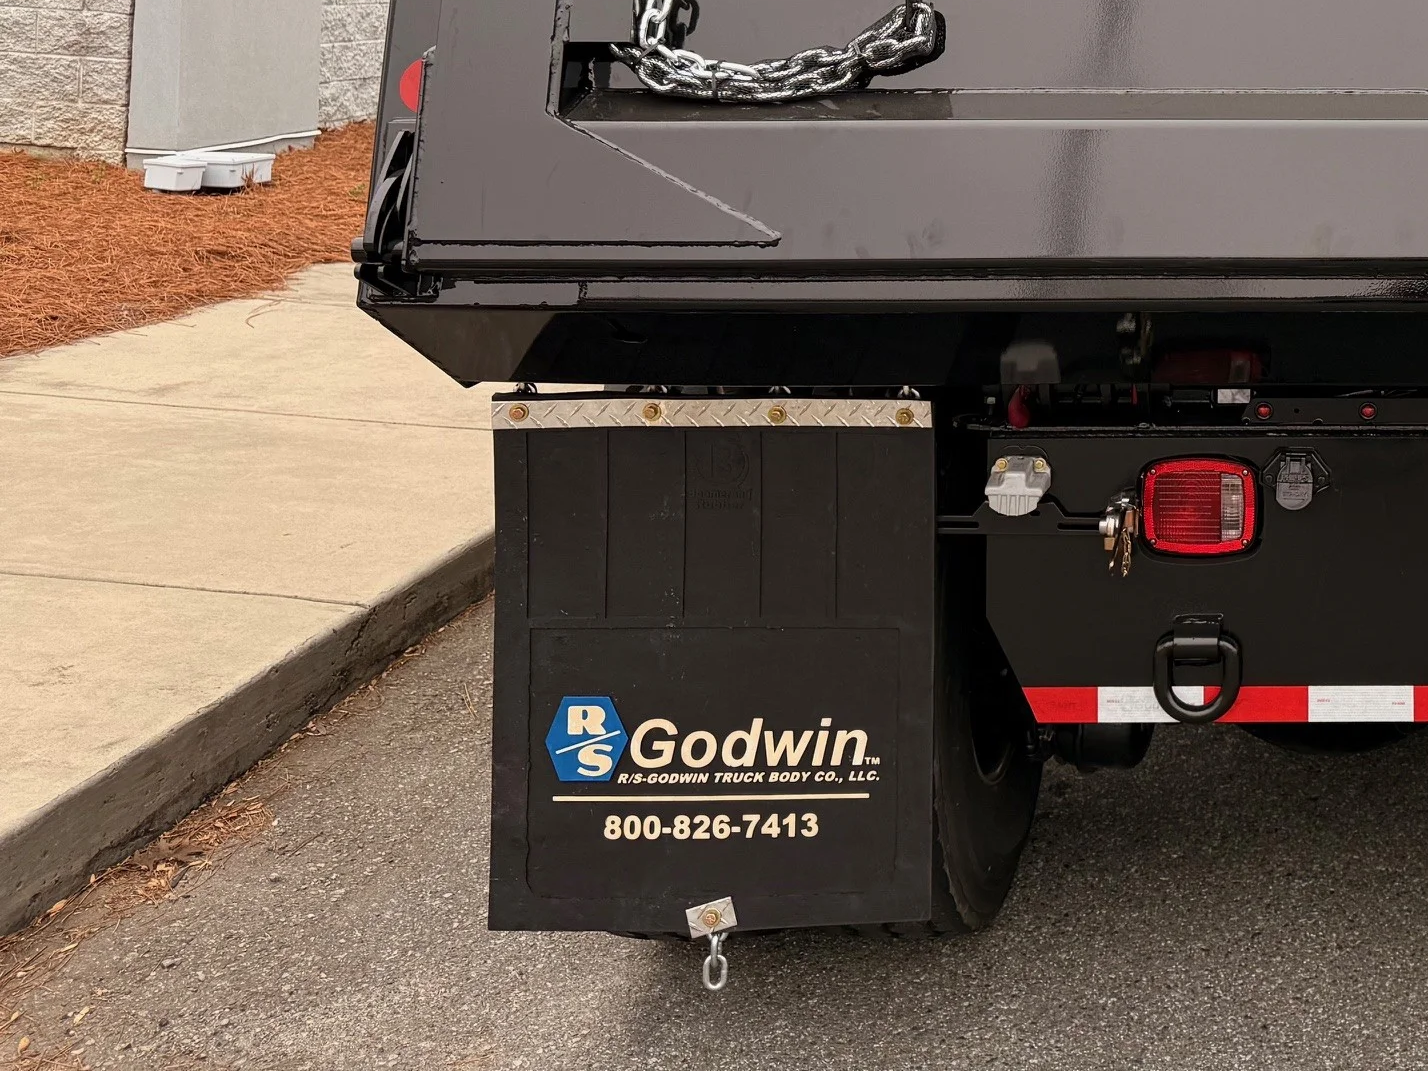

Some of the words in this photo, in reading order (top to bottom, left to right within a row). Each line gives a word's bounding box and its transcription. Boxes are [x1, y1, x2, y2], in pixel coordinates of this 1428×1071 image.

[630, 717, 868, 768] Godwin
[617, 773, 709, 784] R/S-GODWIN
[713, 772, 764, 783] TRUCK
[768, 771, 811, 783] BODY
[814, 771, 843, 784] CO.,
[848, 770, 880, 781] LLC.
[603, 813, 819, 840] 800-826-7413
